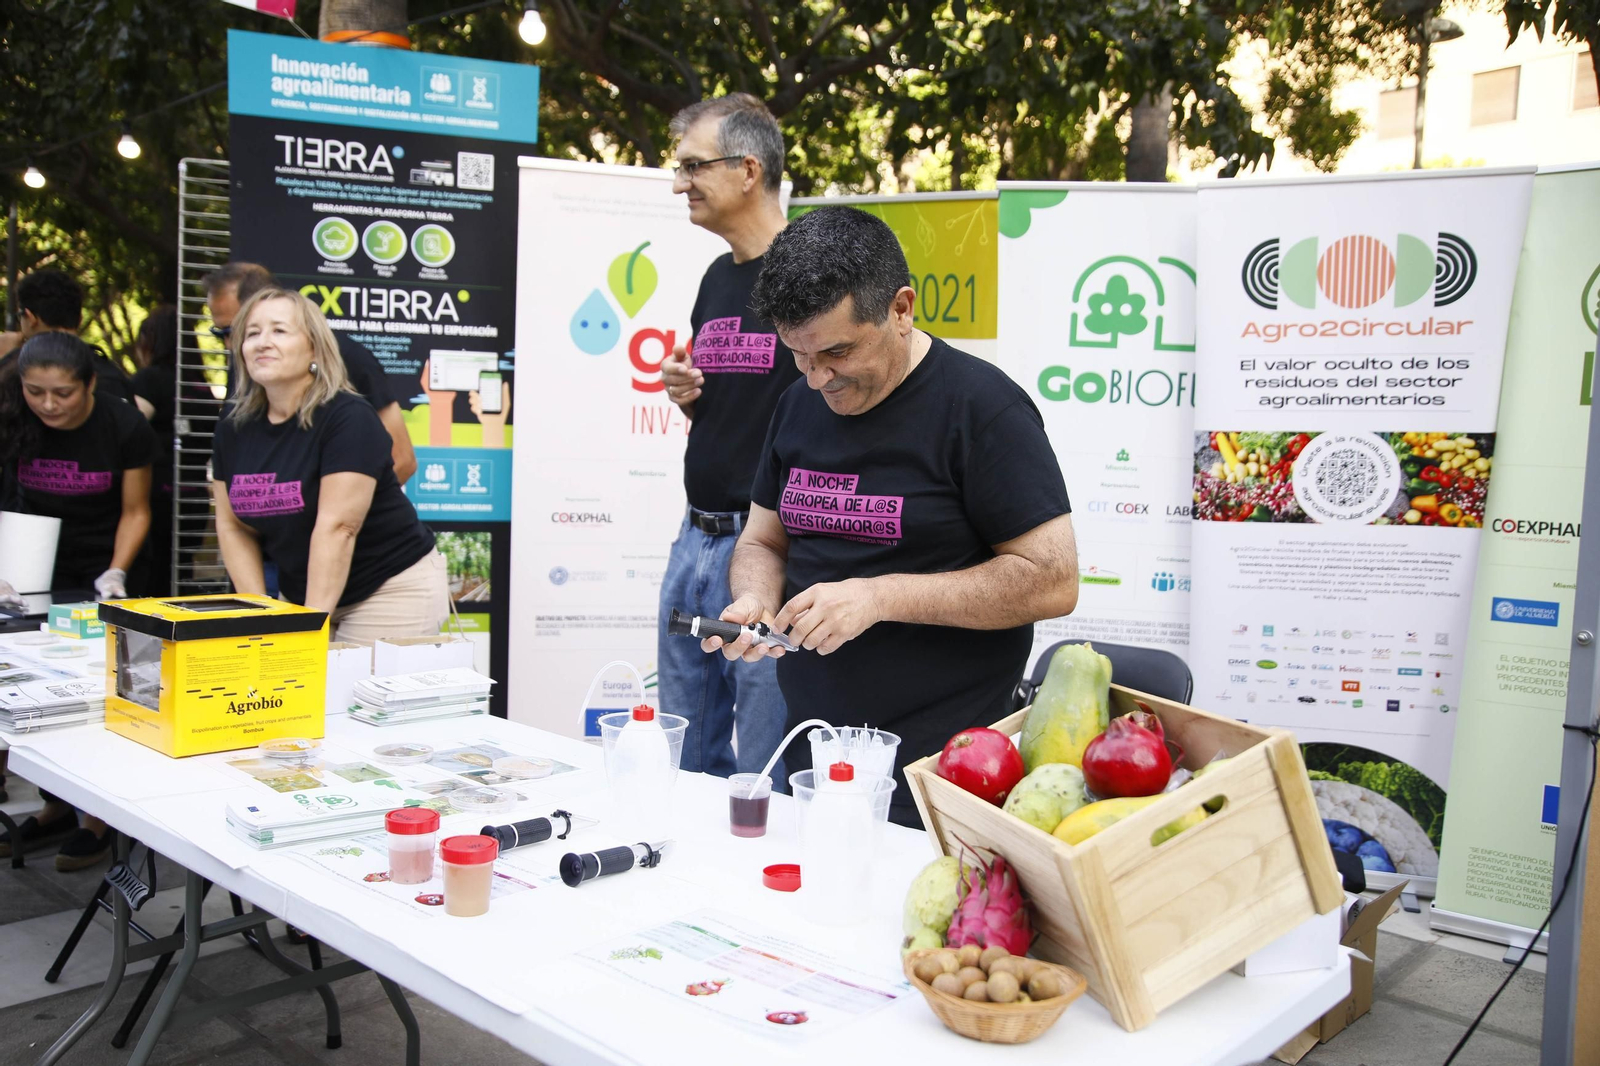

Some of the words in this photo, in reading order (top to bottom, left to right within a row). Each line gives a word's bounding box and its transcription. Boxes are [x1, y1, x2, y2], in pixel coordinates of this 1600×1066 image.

[271, 53, 369, 84] Innovación
[271, 76, 411, 106] agroalimentaria
[274, 134, 395, 175] TIERRA
[312, 202, 373, 214] HERRAMIENTAS
[374, 207, 425, 219] PLATAFORMA
[426, 211, 454, 222] TIERRA
[360, 320, 383, 332] PARA
[384, 321, 430, 334] GESTIONAR
[708, 320, 738, 332] NOCHE
[1241, 317, 1474, 343] Agro2Circular
[733, 335, 745, 347] DE
[747, 336, 772, 348] L@S
[1240, 359, 1256, 371] El
[1264, 357, 1316, 371] valor
[1324, 357, 1393, 371] oculto
[1401, 357, 1429, 370] de
[1437, 356, 1470, 370] los
[1245, 375, 1338, 389] residuos
[1346, 375, 1377, 389] del
[1386, 375, 1463, 389] sector
[1258, 392, 1446, 409] agroalimentarios
[788, 471, 801, 486] LA
[807, 473, 855, 491] NOCHE
[782, 490, 838, 510] EUROPEA
[844, 497, 863, 512] DE
[865, 498, 898, 514] L@S
[1116, 502, 1149, 515] COEX
[551, 512, 613, 523] COEXPHAL
[781, 510, 897, 535] INVESTIGADOR@S
[1492, 518, 1581, 537] COEXPHAL
[1500, 654, 1511, 662] EL
[1512, 655, 1557, 668] OBJETIVO
[1510, 665, 1556, 677] PROCESO
[602, 681, 632, 691] Europa
[1497, 673, 1564, 687] PROCEDENTES
[1499, 683, 1511, 691] UN
[1514, 684, 1566, 698] PRODUCTO
[225, 695, 283, 716] Agrobío
